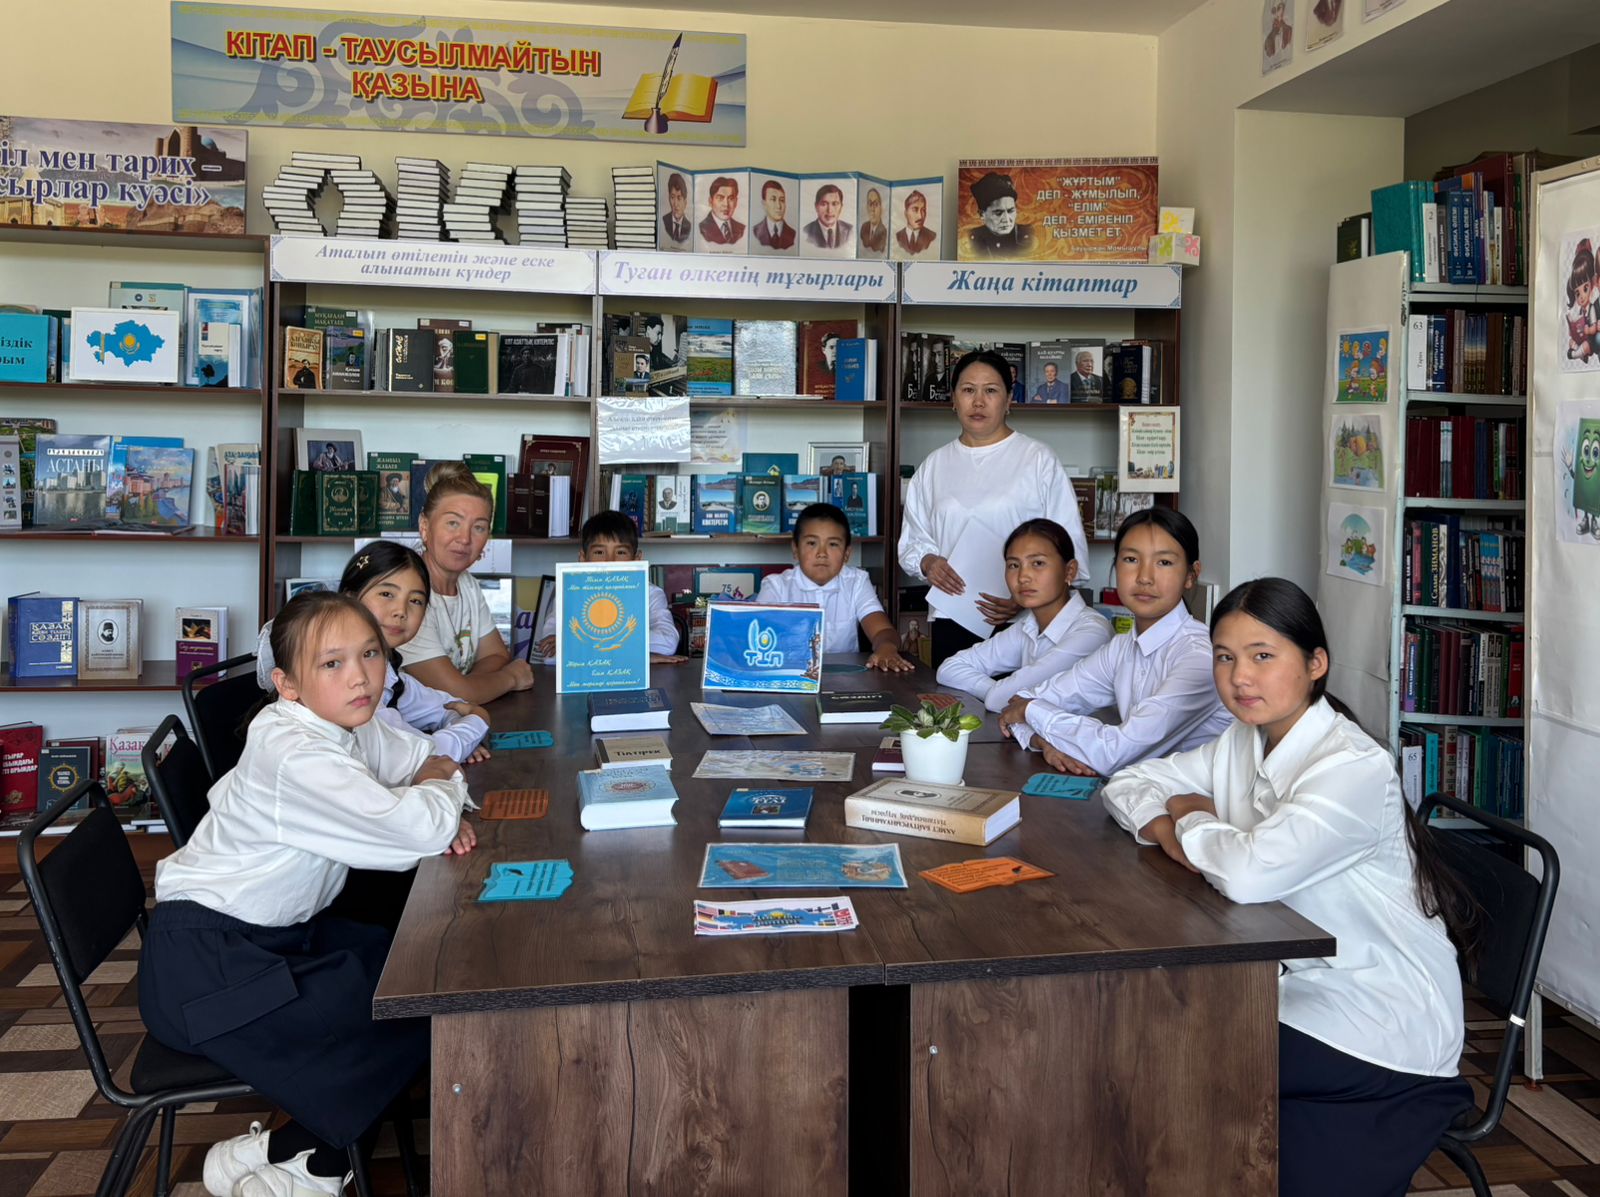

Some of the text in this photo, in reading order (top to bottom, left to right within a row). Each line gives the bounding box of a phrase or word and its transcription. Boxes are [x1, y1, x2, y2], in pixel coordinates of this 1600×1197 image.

[226, 31, 314, 60] КІТАП
[340, 37, 600, 76] ТАУСЫЛМАЙТЫН
[352, 71, 484, 102] ҚАЗЫНА
[39, 150, 96, 170] мен
[105, 154, 196, 180] тарих
[119, 178, 210, 209] куәсі»
[1036, 190, 1061, 201] ДЕП
[1042, 215, 1067, 226] ДЕП
[1077, 214, 1133, 225] ЕМІРЕНІП
[1053, 227, 1104, 239] ҚЫЗМЕТ
[315, 245, 555, 268] Аталып өтілетін және еске
[360, 263, 511, 283] алынатын күндер
[614, 261, 884, 289] Туған өлкенің тұғырлары
[947, 270, 1138, 299] Жаңа кітаптар
[1413, 322, 1423, 330] 63
[46, 458, 104, 473] АСТАНЫ
[722, 584, 732, 593] 75
